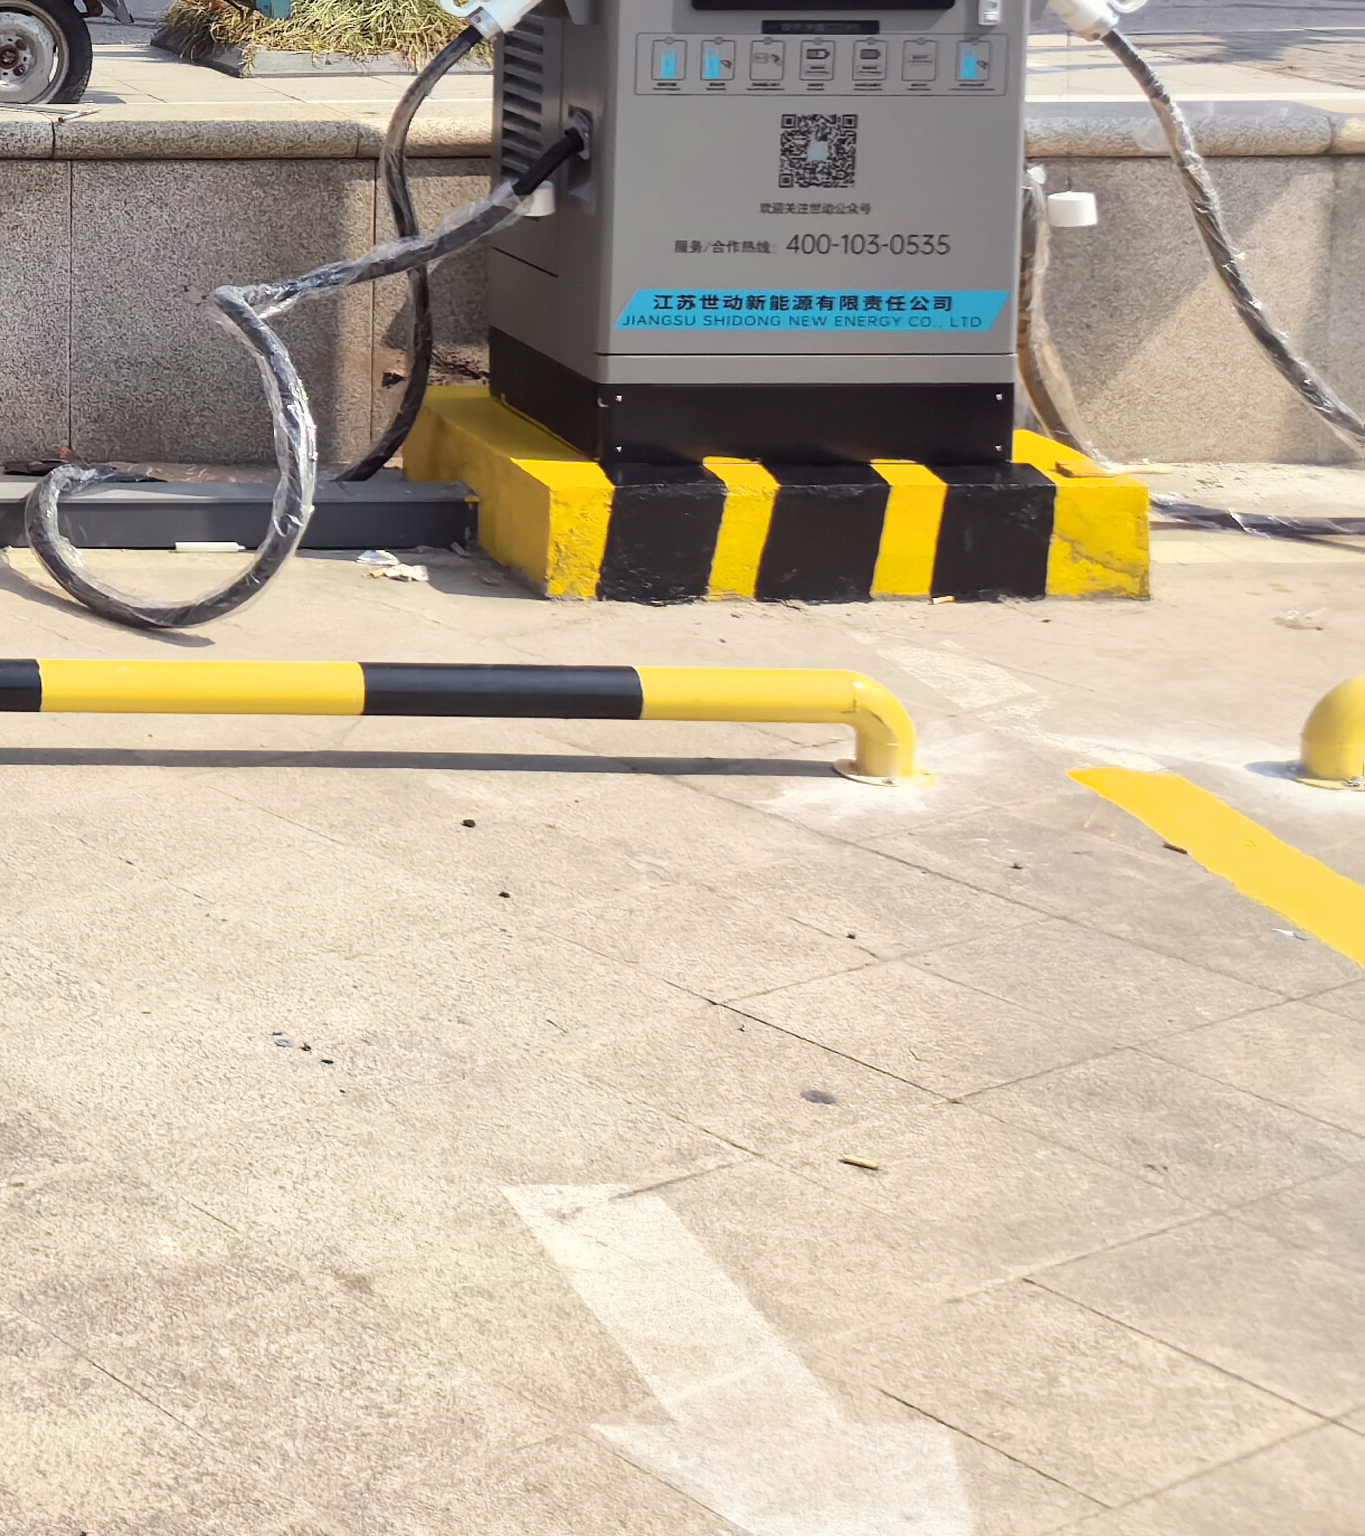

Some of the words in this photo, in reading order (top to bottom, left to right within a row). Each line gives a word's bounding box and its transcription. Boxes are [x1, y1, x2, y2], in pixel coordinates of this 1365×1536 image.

[786, 233, 951, 255] 400-103-0535
[653, 294, 953, 312] 江苏世动新能源有限责任公司
[622, 315, 697, 327] JIANGSU
[703, 315, 781, 327] SHIDONG
[789, 315, 827, 327] NEW
[835, 315, 901, 327] ENERGY
[950, 315, 983, 327] LTD
